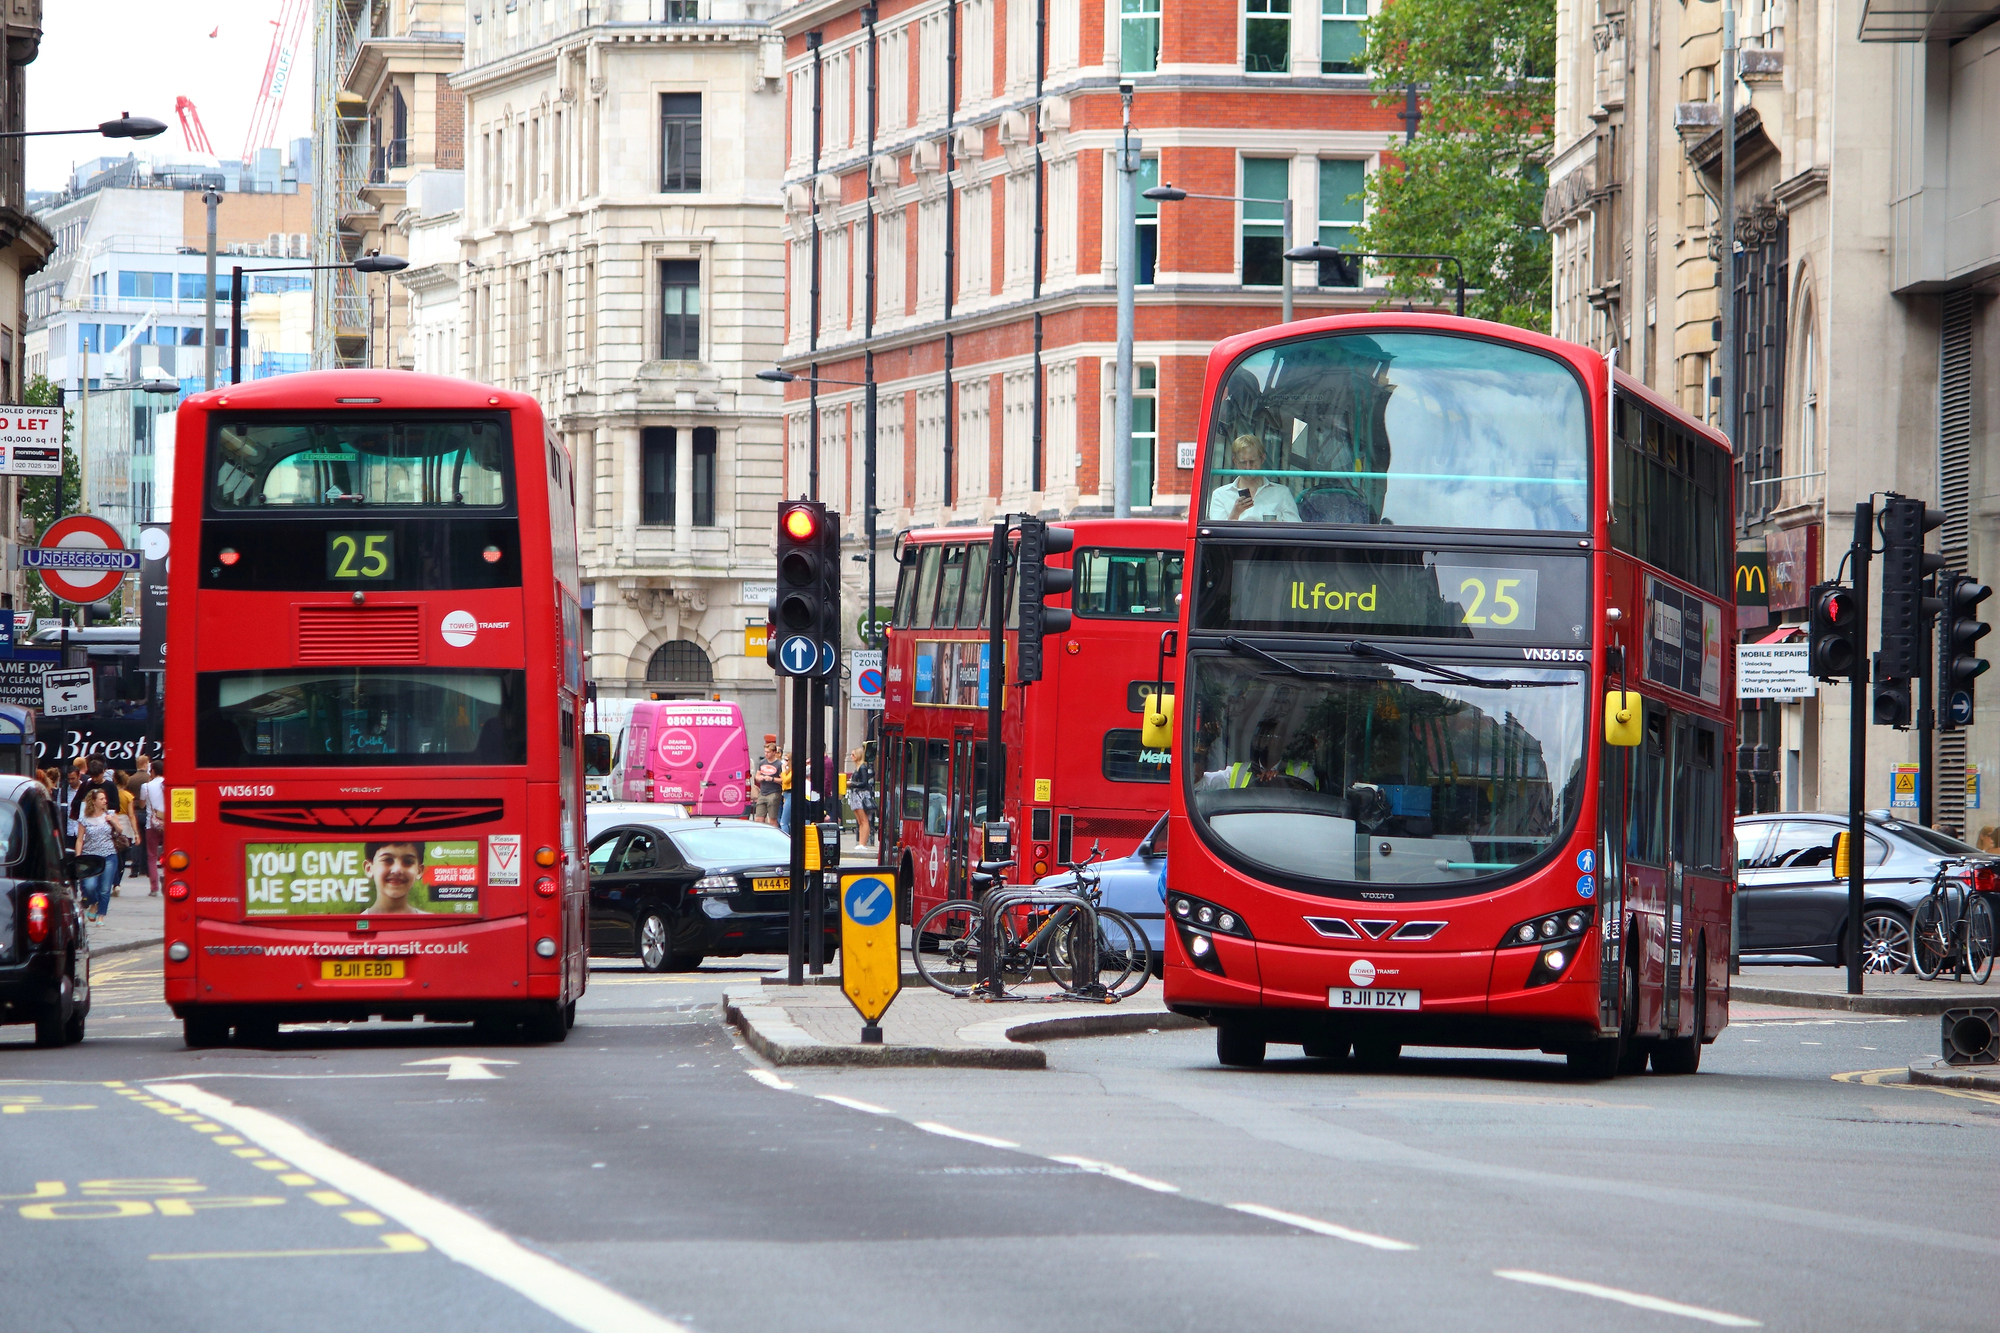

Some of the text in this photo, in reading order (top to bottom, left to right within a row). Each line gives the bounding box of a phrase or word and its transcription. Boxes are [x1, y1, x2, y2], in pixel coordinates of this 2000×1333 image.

[272, 47, 291, 93] WOLFF
[17, 418, 49, 430] LET
[1180, 448, 1197, 457] SOU
[27, 550, 136, 569] UNDERGROUND
[332, 535, 387, 578] 25
[1291, 578, 1521, 625] Ilford 25
[1523, 648, 1584, 662] VN36156
[51, 704, 88, 713] Bus lane
[667, 716, 733, 726] 0800 526488
[219, 785, 274, 797] VN36150
[660, 785, 682, 793] Lanes
[248, 850, 358, 877] YOU GIVE
[434, 874, 457, 882] ZAKAT
[459, 867, 475, 875] YOUR
[247, 877, 370, 904] WE SERVE
[757, 878, 781, 889] M444
[204, 941, 469, 957] VOLVO www.towertransit.co.uk
[334, 963, 392, 977] BJ11 EBD
[1342, 990, 1407, 1006] BJ11 DZY
